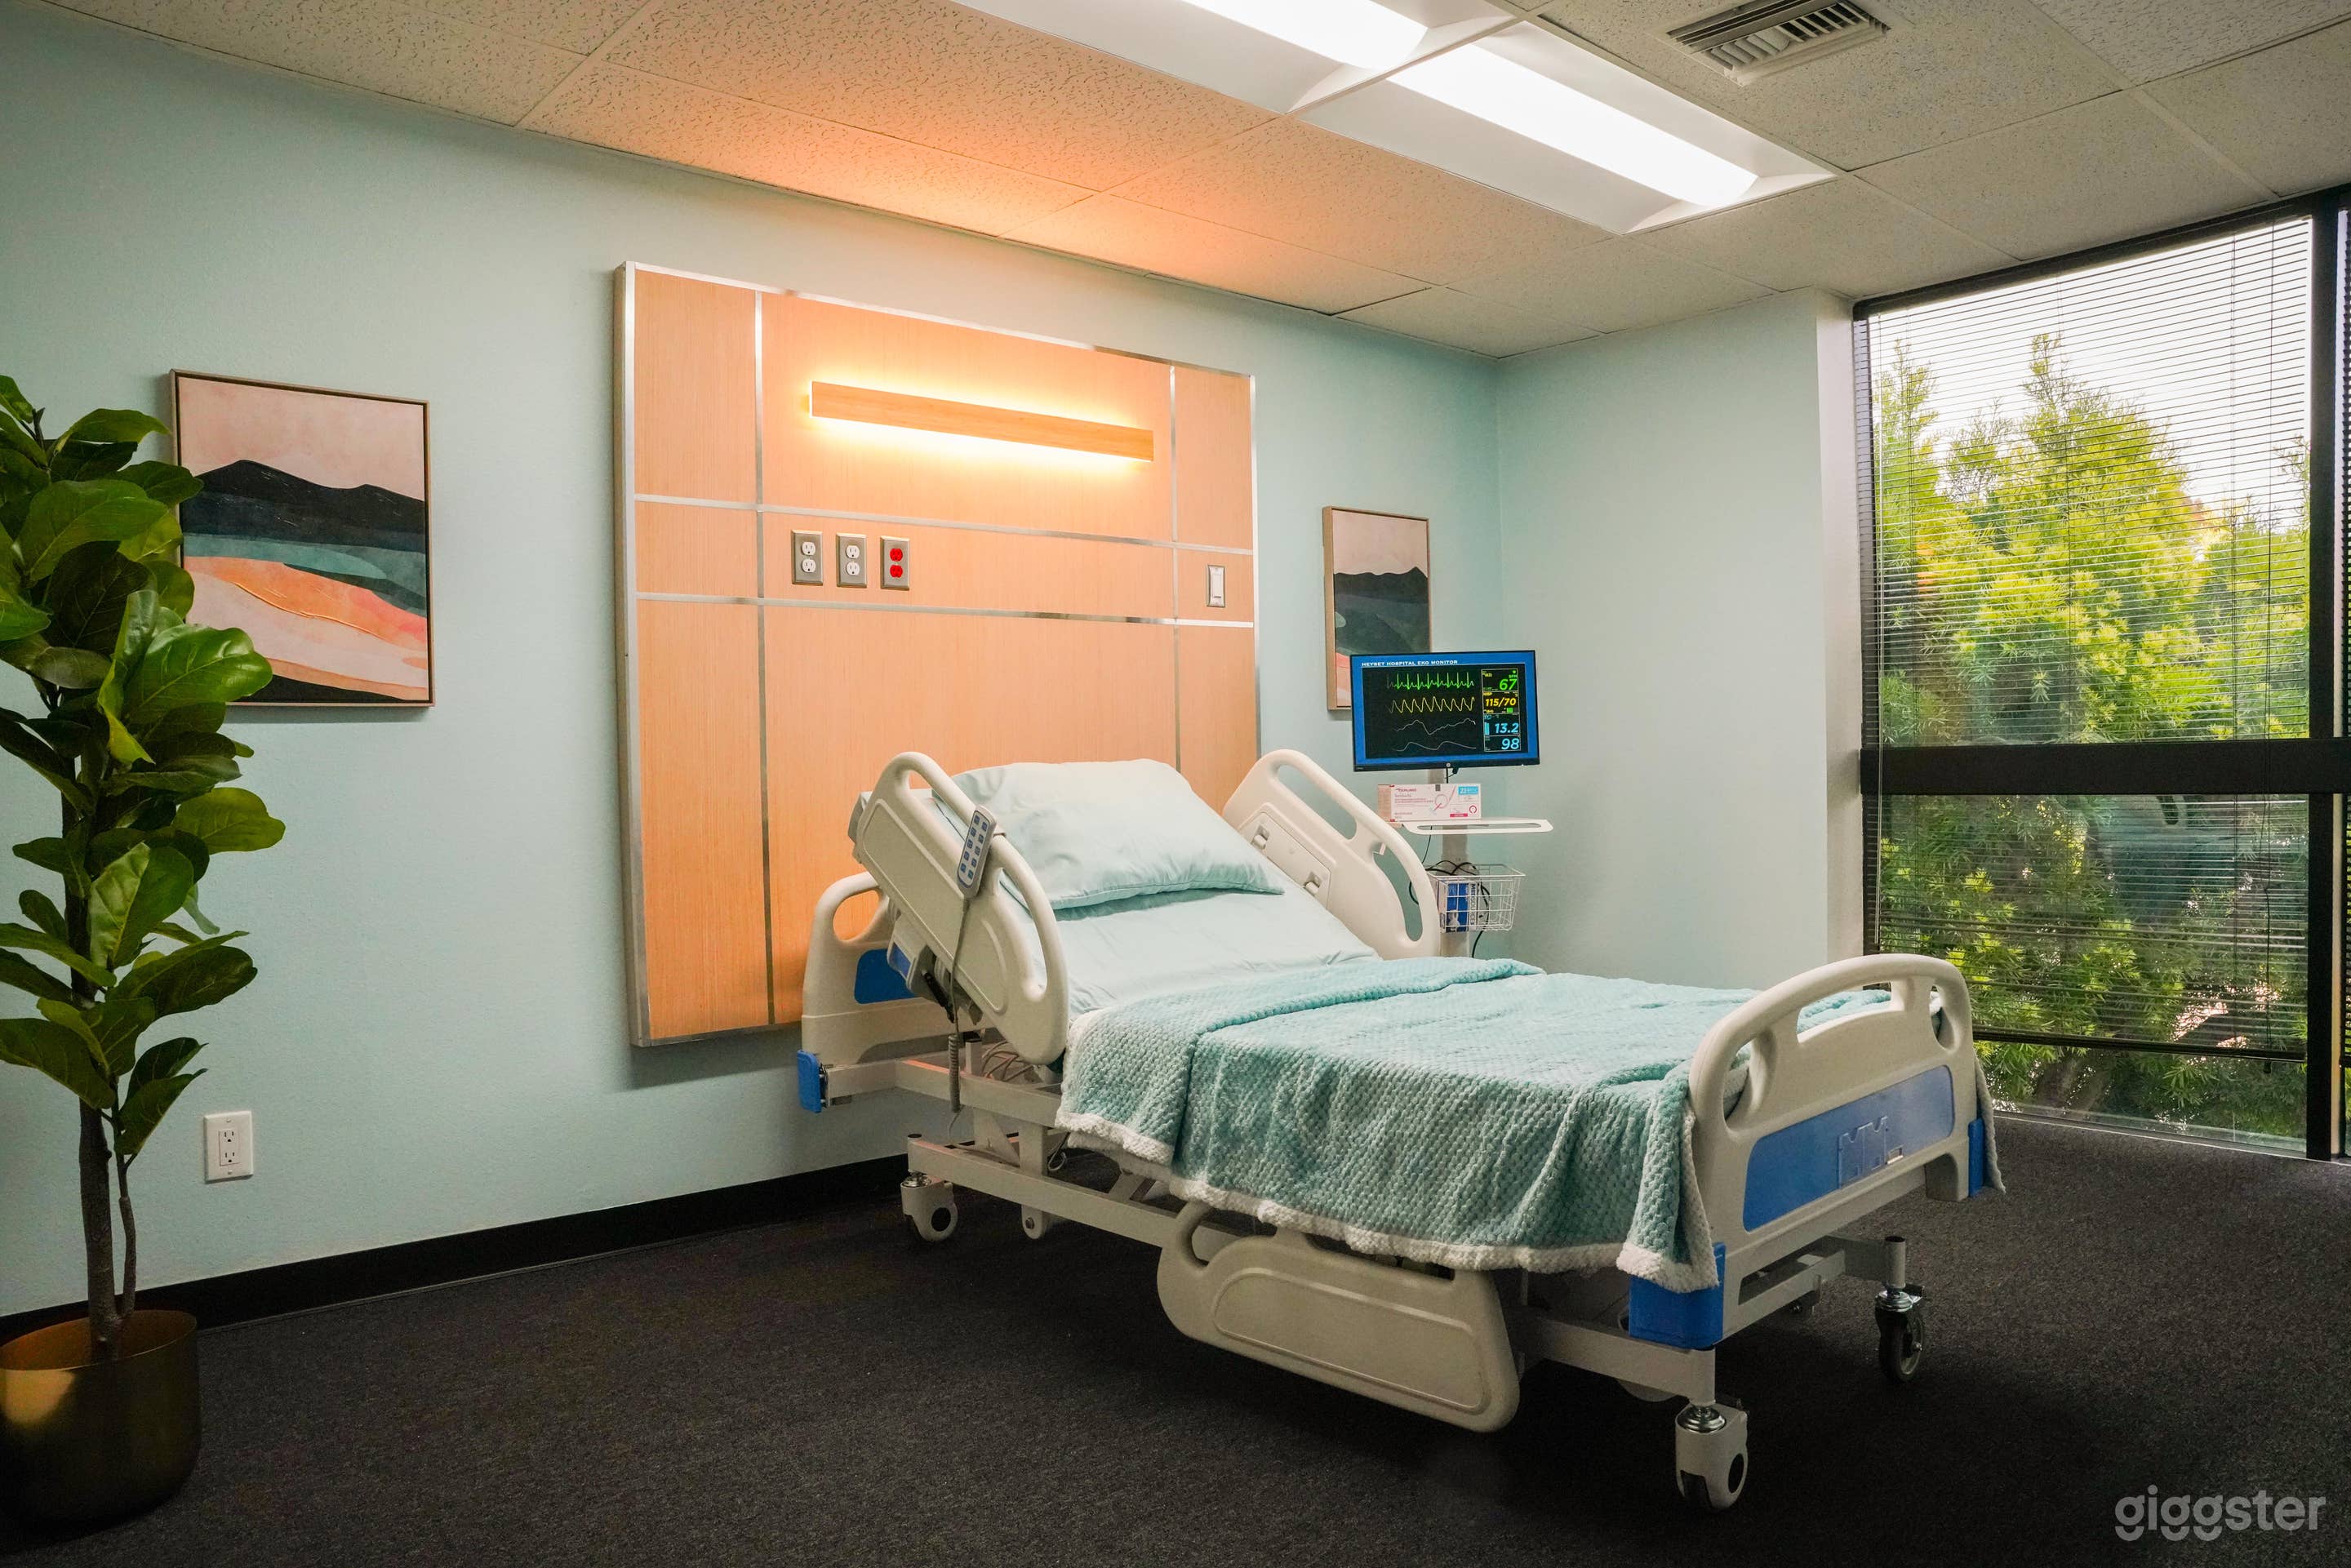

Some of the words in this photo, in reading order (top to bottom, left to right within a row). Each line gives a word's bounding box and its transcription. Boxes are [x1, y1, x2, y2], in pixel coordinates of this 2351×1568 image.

[1499, 678, 1518, 691] 67
[1485, 697, 1517, 708] 115/70
[1495, 722, 1519, 734] 13.2
[1501, 738, 1520, 750] 98
